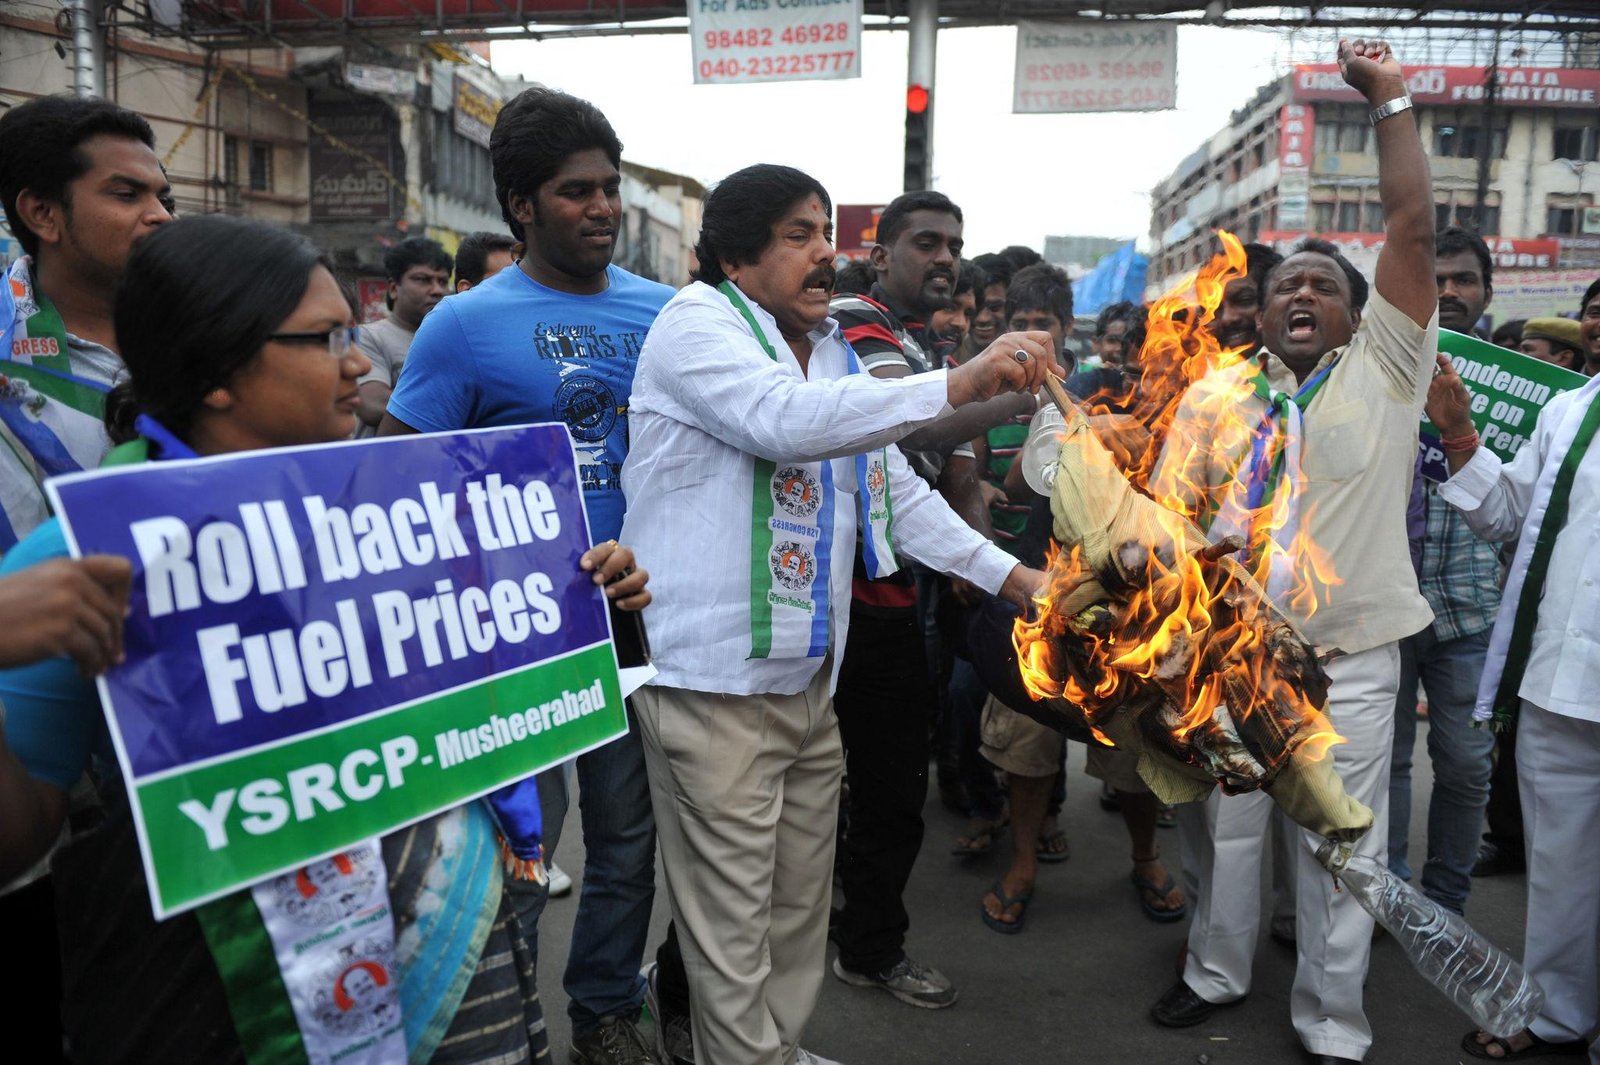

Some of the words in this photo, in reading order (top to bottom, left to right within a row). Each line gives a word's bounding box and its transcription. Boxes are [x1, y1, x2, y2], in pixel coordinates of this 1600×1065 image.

[705, 28, 773, 49] 98482
[782, 22, 848, 45] 46928
[700, 52, 854, 78] 040-23225777
[534, 321, 597, 339] Extreme
[1490, 400, 1526, 428] on
[129, 499, 307, 618] Roll
[302, 481, 470, 583] back
[466, 473, 562, 552] the
[196, 598, 374, 725] Fuel
[371, 571, 562, 679] Prices
